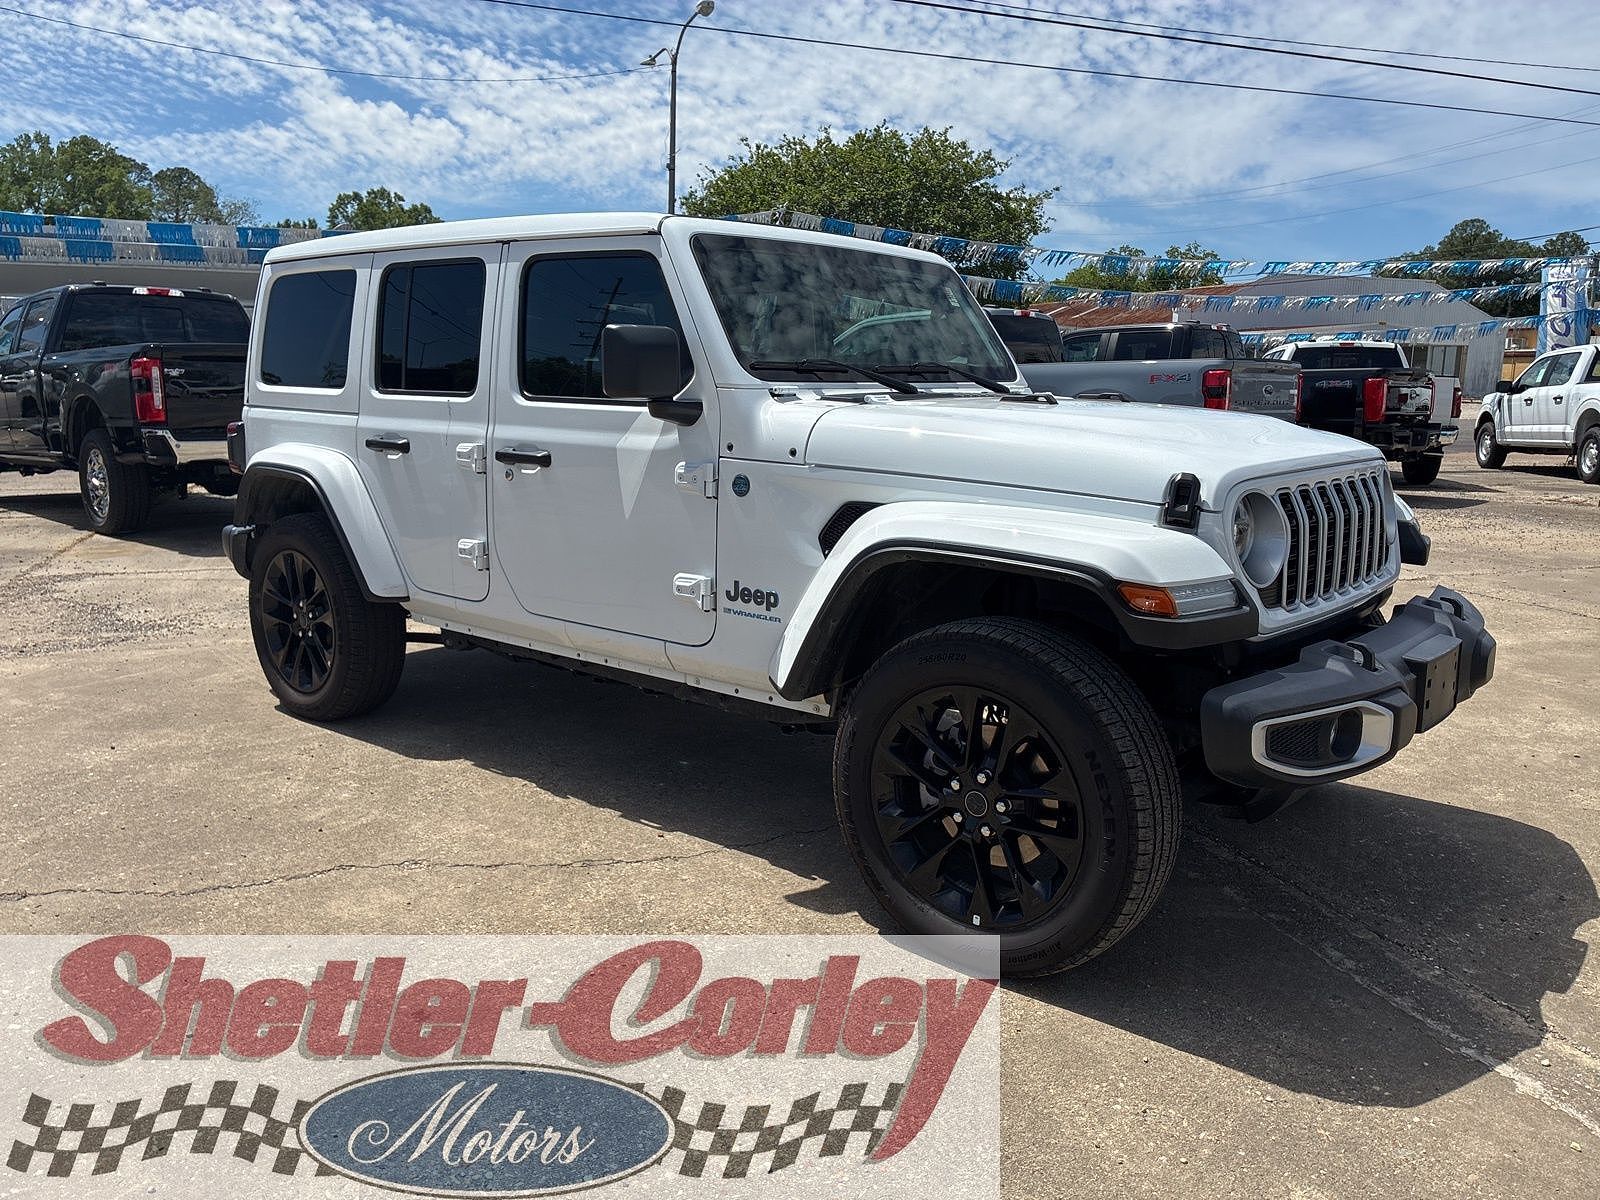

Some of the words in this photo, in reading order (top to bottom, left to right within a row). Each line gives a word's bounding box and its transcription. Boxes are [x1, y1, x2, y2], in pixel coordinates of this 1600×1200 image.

[1149, 373, 1191, 384] FX4
[725, 580, 780, 612] Jeep
[731, 609, 782, 623] WRANGLER
